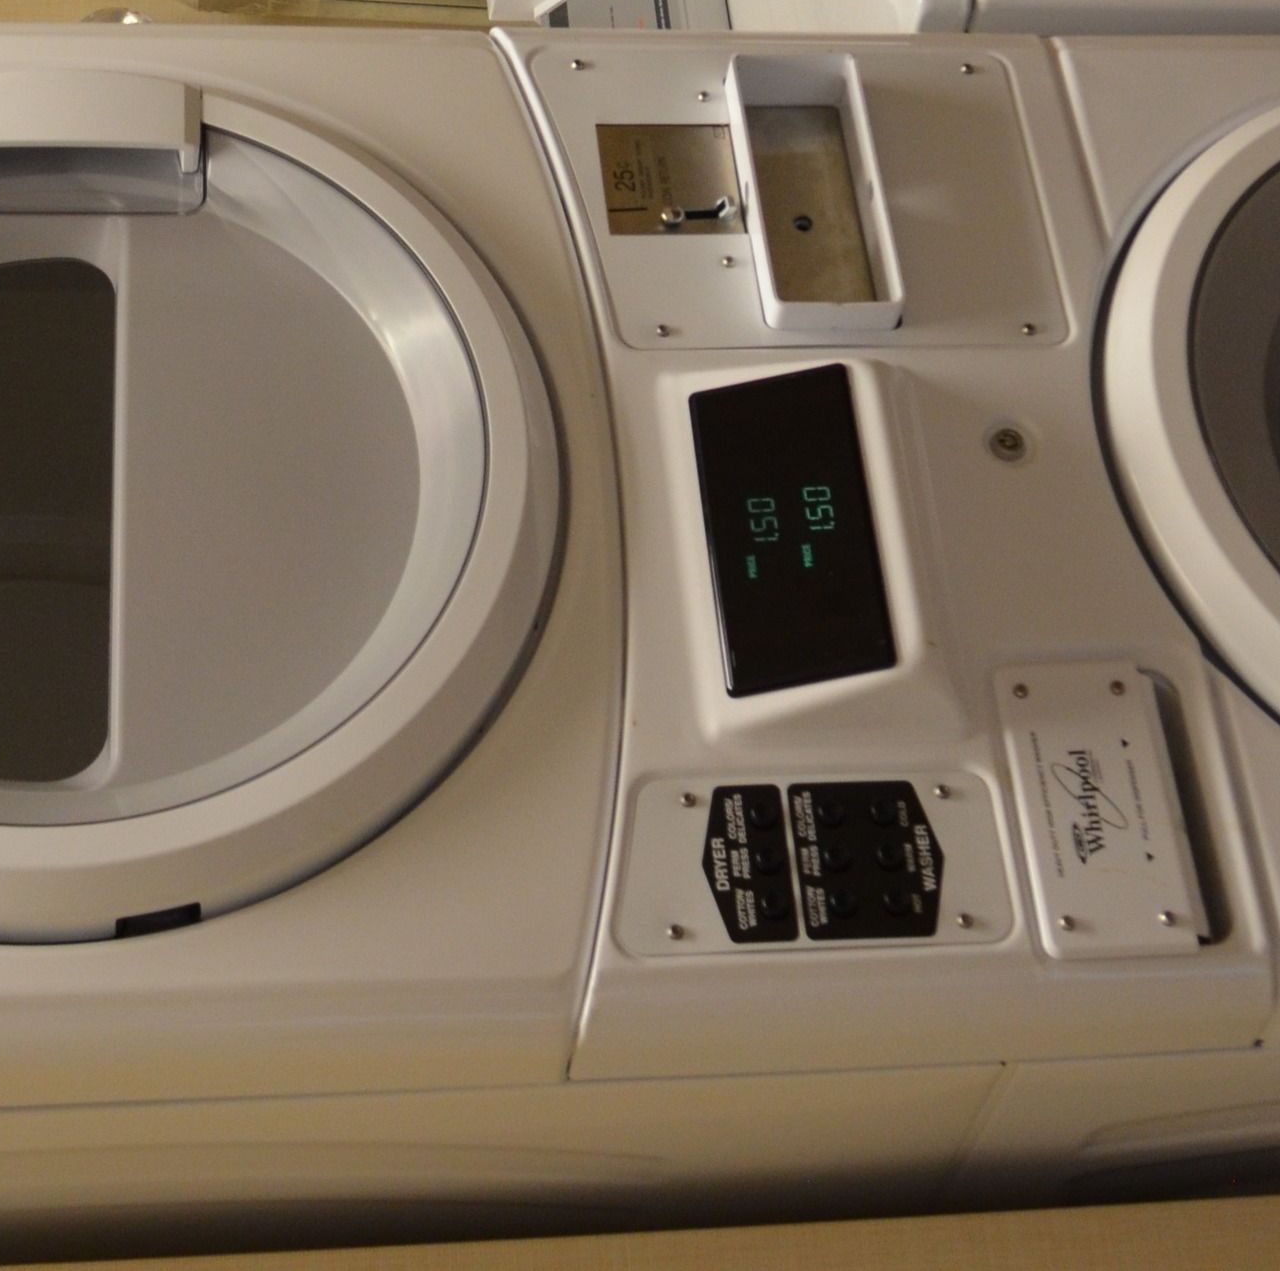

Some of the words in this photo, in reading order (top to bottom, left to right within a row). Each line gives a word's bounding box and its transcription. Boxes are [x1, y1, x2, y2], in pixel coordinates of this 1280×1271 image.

[747, 498, 779, 541] 1.50
[803, 486, 835, 530] 1.50
[802, 544, 813, 567] PRICE
[733, 794, 747, 844] DELICATES
[802, 791, 817, 841] DELICATES
[897, 801, 909, 827] COLD
[1068, 750, 1106, 855] Whirlpool
[711, 837, 730, 891] DRYER
[730, 850, 741, 877] PERM
[740, 848, 751, 879] PRESS
[801, 847, 812, 875] PERM
[810, 845, 821, 877] PRESS
[914, 825, 937, 891] WASHER
[744, 890, 757, 927] WHITES
[816, 888, 829, 925] WHITES
